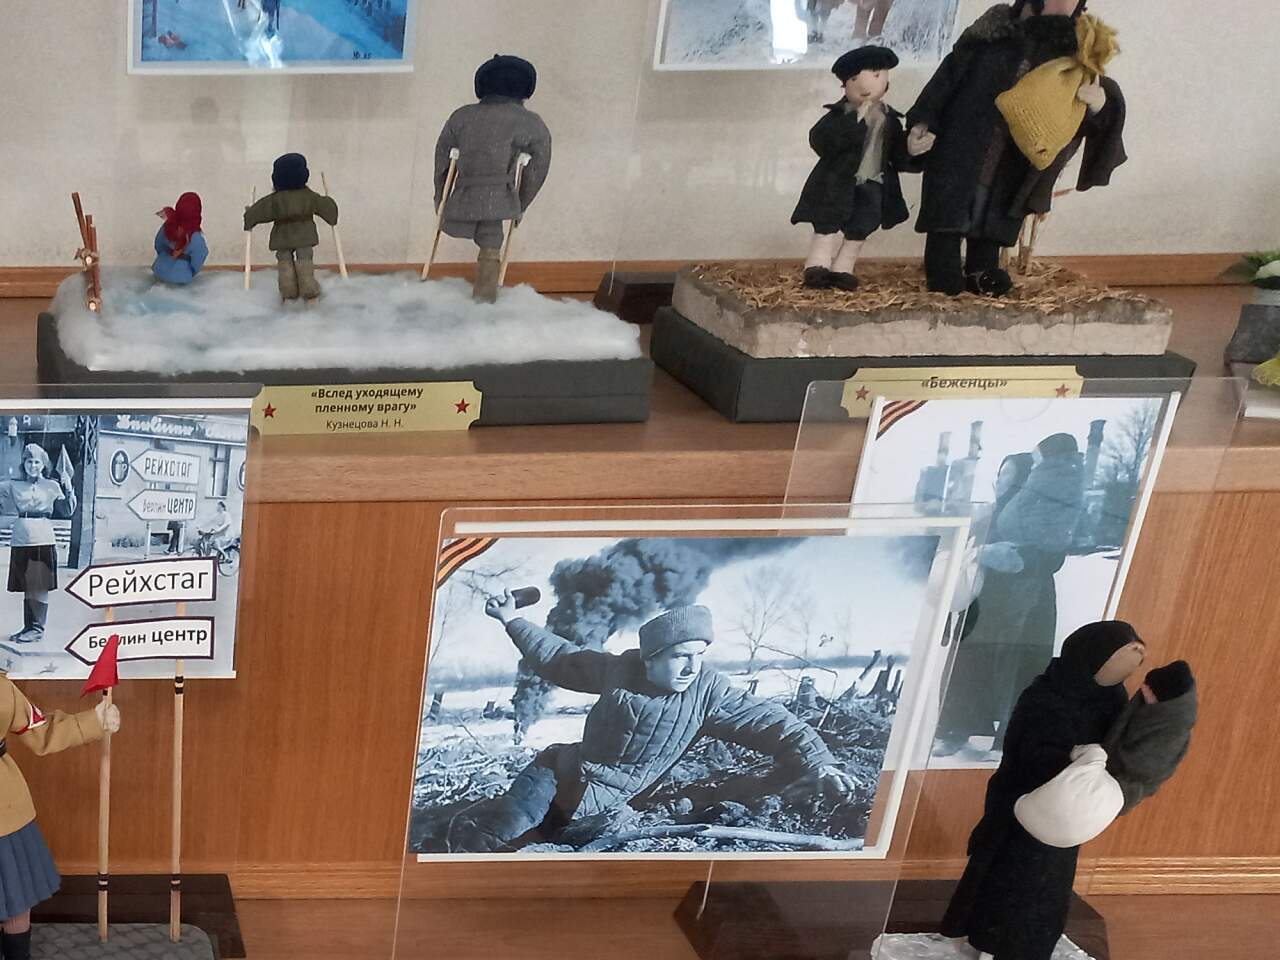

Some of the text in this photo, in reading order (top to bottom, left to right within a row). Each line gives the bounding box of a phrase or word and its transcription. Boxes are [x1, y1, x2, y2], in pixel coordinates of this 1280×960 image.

[921, 376, 1008, 391] «Беженцы»
[311, 387, 424, 400] «Вслед уходящему
[315, 402, 417, 414] пленному врагу»
[326, 418, 405, 431] Кузнецова Н. Н.
[144, 456, 193, 478] РЕЙХСТАГ
[88, 569, 209, 597] Рейхстаг
[89, 628, 208, 649] Белин центр
